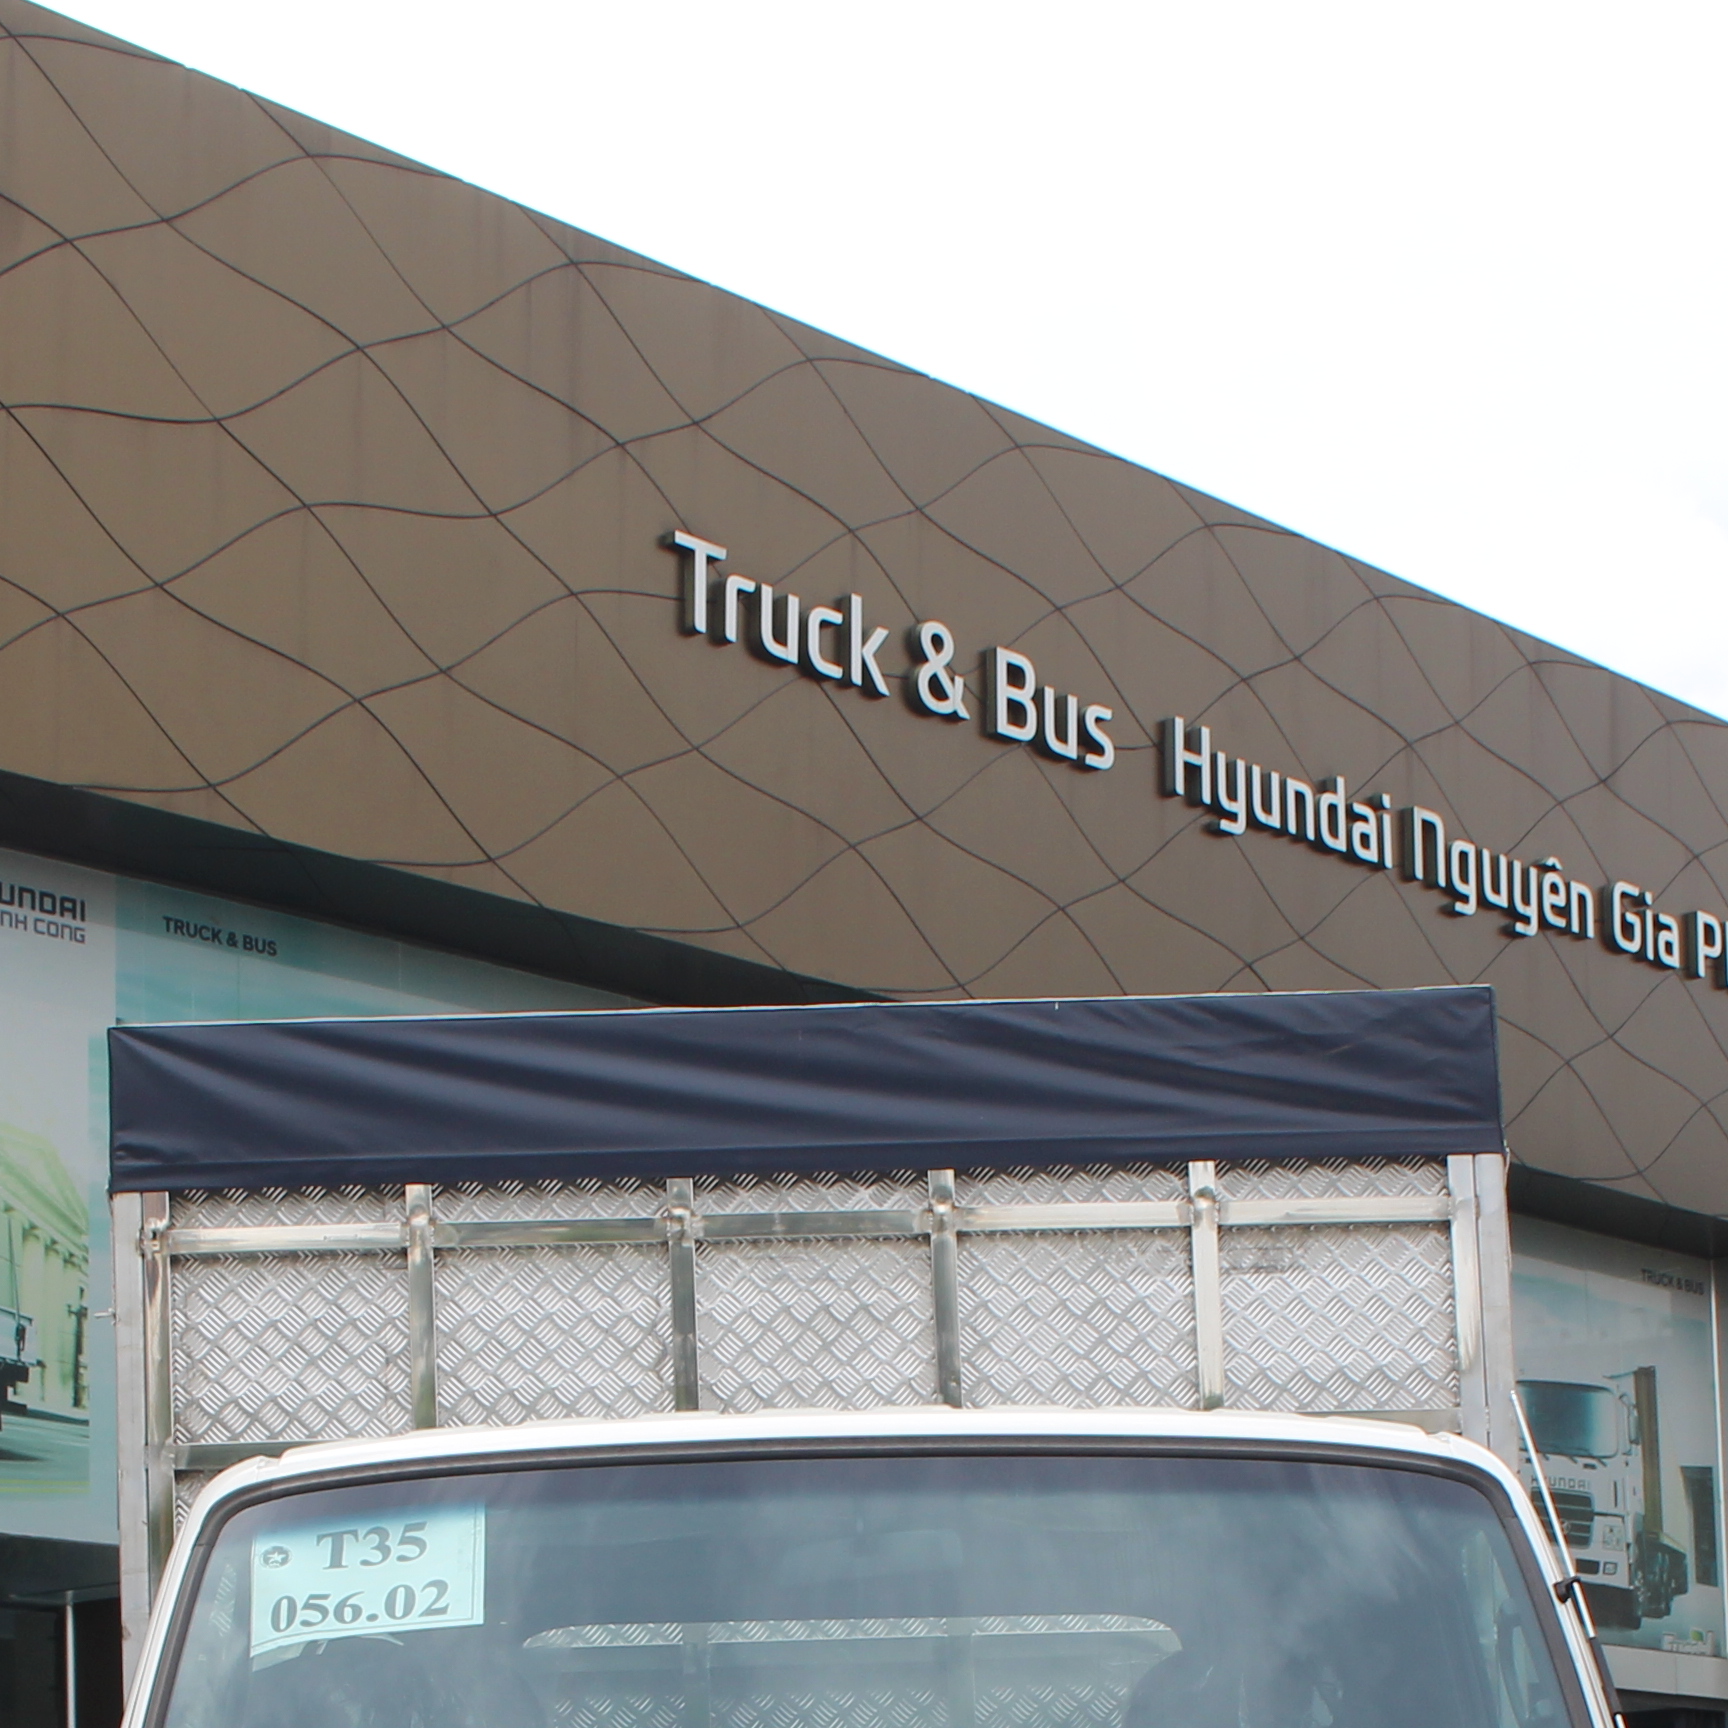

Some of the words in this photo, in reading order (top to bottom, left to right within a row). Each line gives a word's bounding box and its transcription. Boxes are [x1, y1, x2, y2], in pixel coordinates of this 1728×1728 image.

[670, 529, 890, 698] Truck
[914, 619, 971, 720] &
[992, 645, 1116, 771] Bus
[1170, 715, 1394, 870] Hyundai
[1410, 804, 1595, 938] Nguyên
[1610, 880, 1681, 969] Gia
[33, 917, 86, 944] CONG
[162, 915, 222, 946] TRUCK
[226, 932, 239, 949] &
[242, 933, 278, 957] BUS
[316, 1521, 428, 1570] T35
[271, 1579, 451, 1633] 056.02
